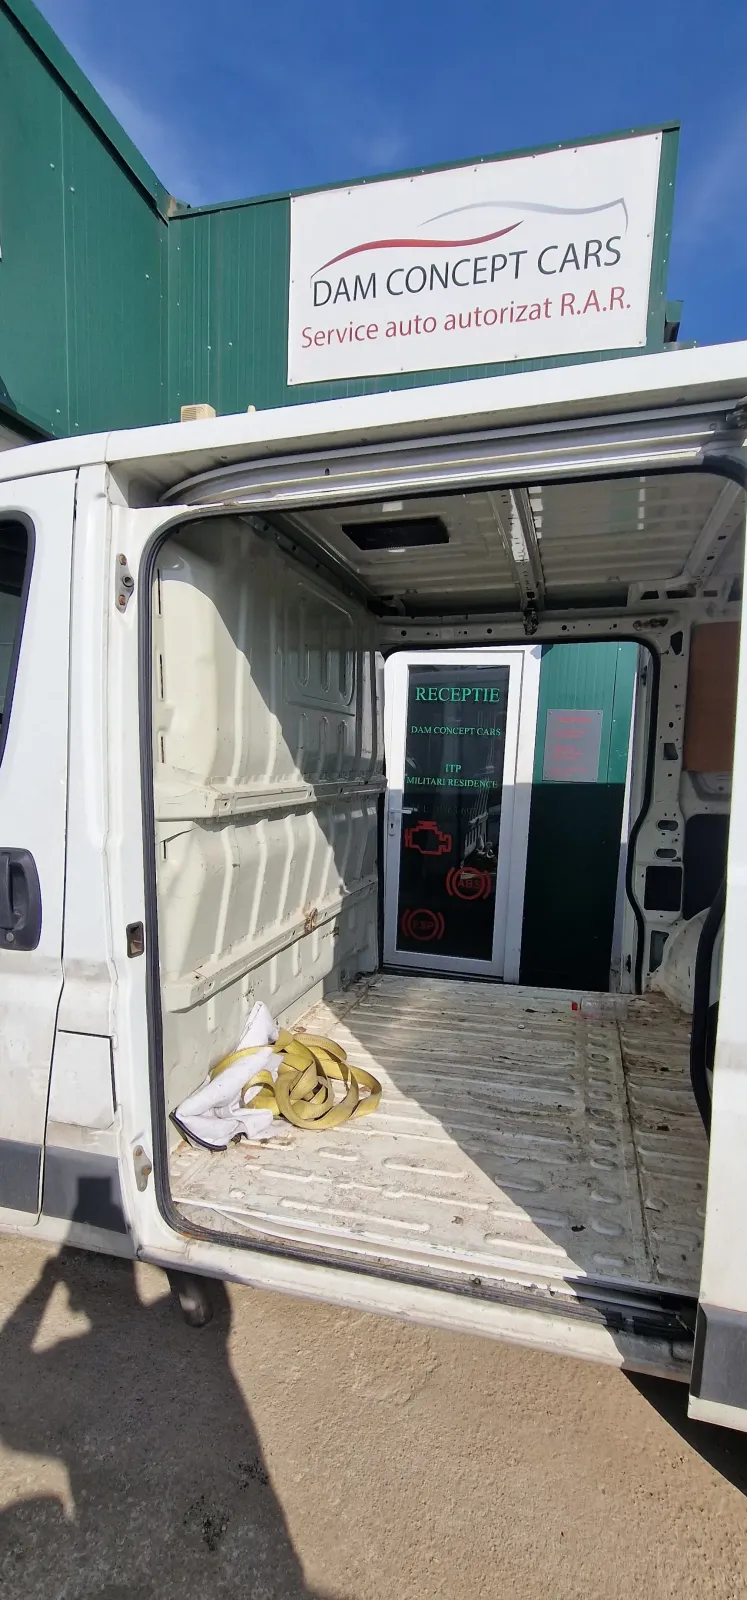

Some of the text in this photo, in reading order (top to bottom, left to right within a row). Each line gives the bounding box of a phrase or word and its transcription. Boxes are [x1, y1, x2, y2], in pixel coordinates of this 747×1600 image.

[313, 235, 622, 307] DAM CONCEPT CARS
[301, 286, 632, 349] Service auto autorizat R.A.R.
[415, 687, 500, 702] RECEPTIE
[411, 725, 501, 736] DAM CONCEPT CARS
[445, 763, 462, 773] ITP
[406, 776, 498, 788] MILITARI RESIDENCE
[457, 878, 480, 889] ABS
[412, 920, 434, 930] ESP
